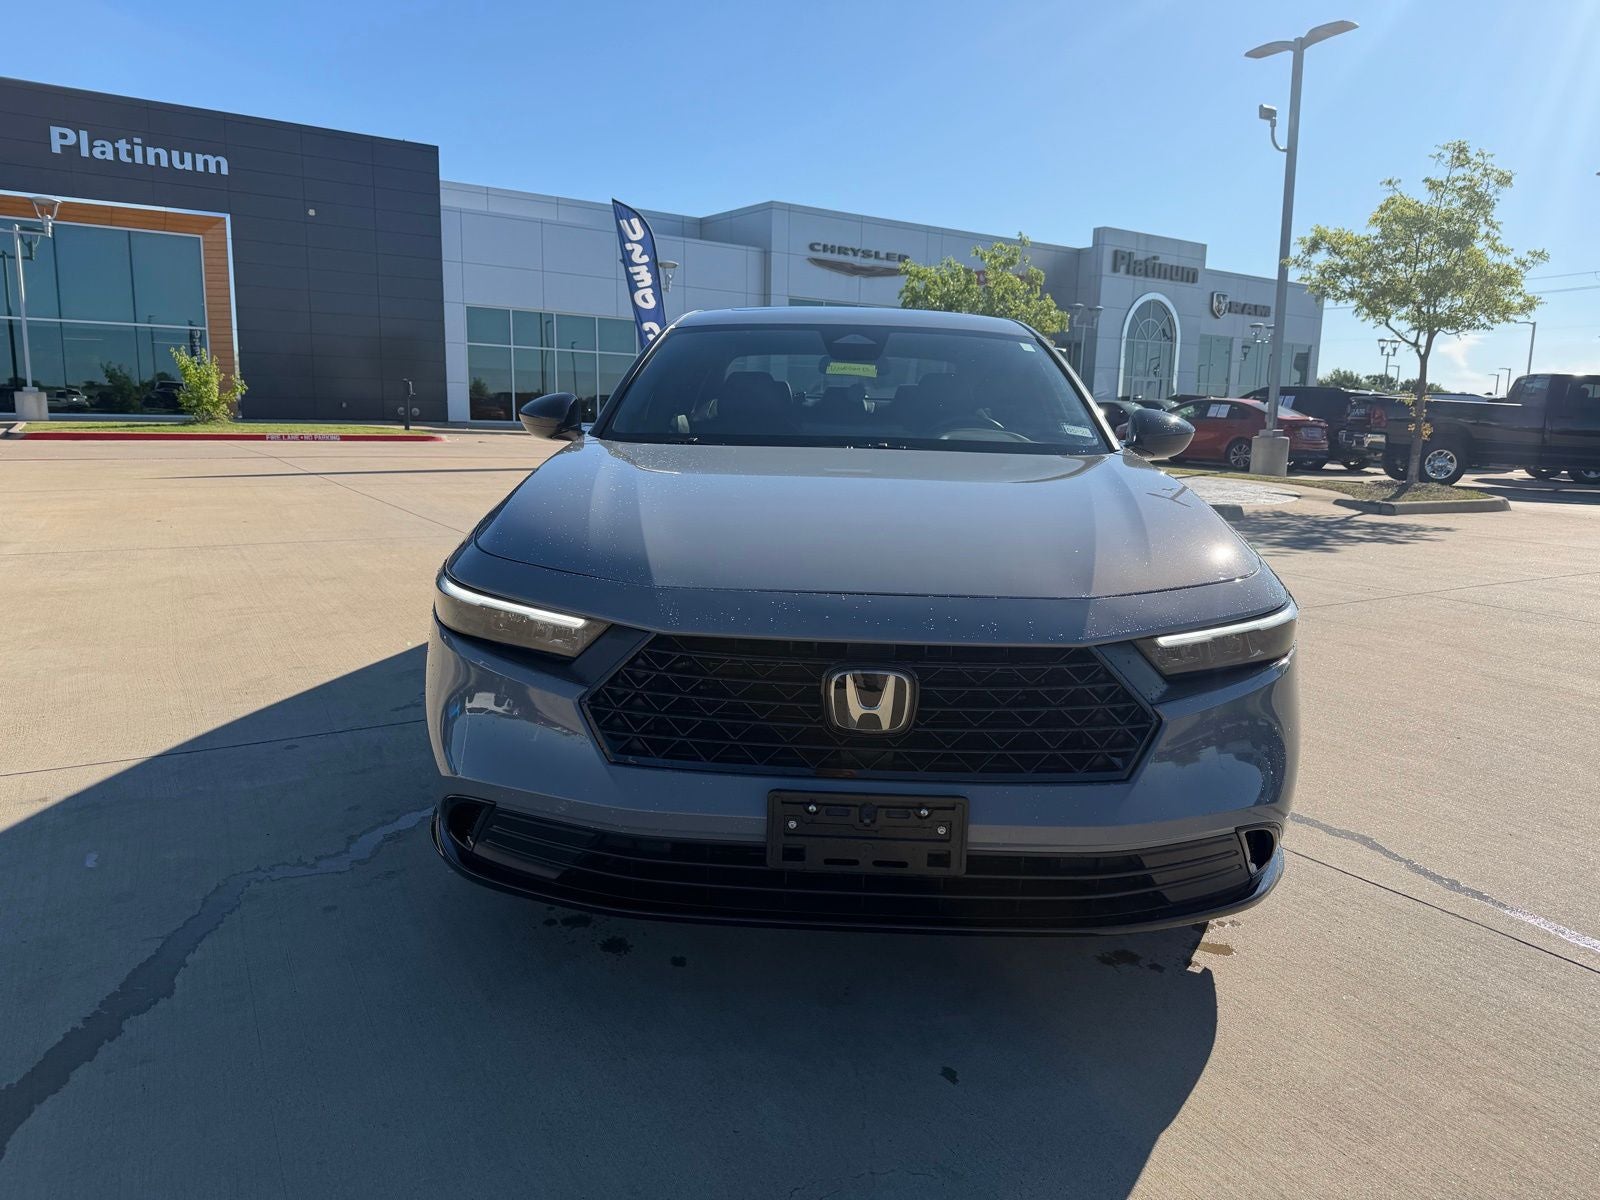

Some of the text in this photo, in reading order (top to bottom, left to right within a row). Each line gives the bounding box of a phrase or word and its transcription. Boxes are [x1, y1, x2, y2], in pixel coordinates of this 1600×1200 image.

[50, 126, 229, 175] Platinum
[808, 242, 911, 263] CHRYSLER
[1112, 249, 1199, 284] Platinum
[1228, 301, 1271, 317] RAM
[266, 433, 341, 441] FIRE LANE NO PARKING
